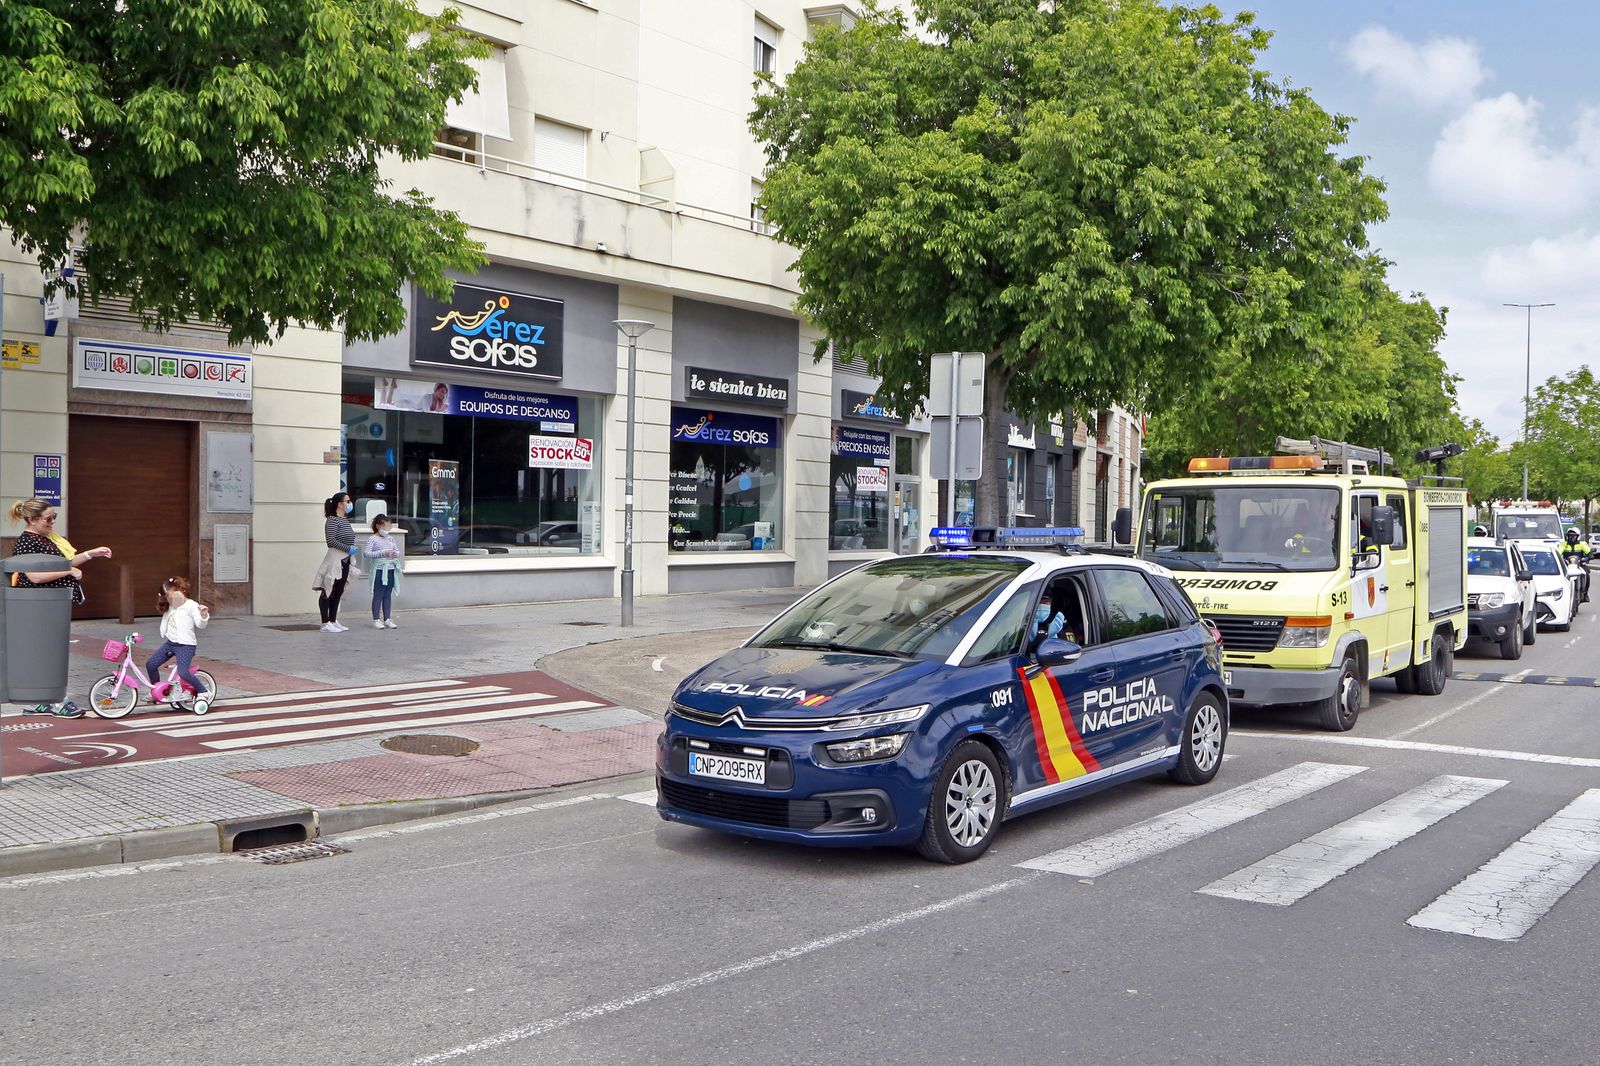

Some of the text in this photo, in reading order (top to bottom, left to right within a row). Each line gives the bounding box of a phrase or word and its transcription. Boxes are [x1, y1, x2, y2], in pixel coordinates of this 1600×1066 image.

[449, 336, 538, 368] sofas
[690, 374, 787, 400] te sienta bien
[484, 391, 549, 404] Disfruta de los mejores
[460, 400, 571, 420] EQUIPOS DE DESCANSO
[733, 429, 769, 444] sofas
[530, 446, 574, 460] STOCK
[838, 441, 890, 456] PRECIOS EN SOFÁS
[857, 475, 879, 485] STOCK
[1194, 602, 1229, 610] OTEC-FIRE
[1331, 590, 1348, 607] S-13
[703, 682, 808, 701] POLICÍA
[992, 687, 1013, 707] 091
[1083, 677, 1157, 712] POLICÍA
[1082, 695, 1173, 734] NACIONAL
